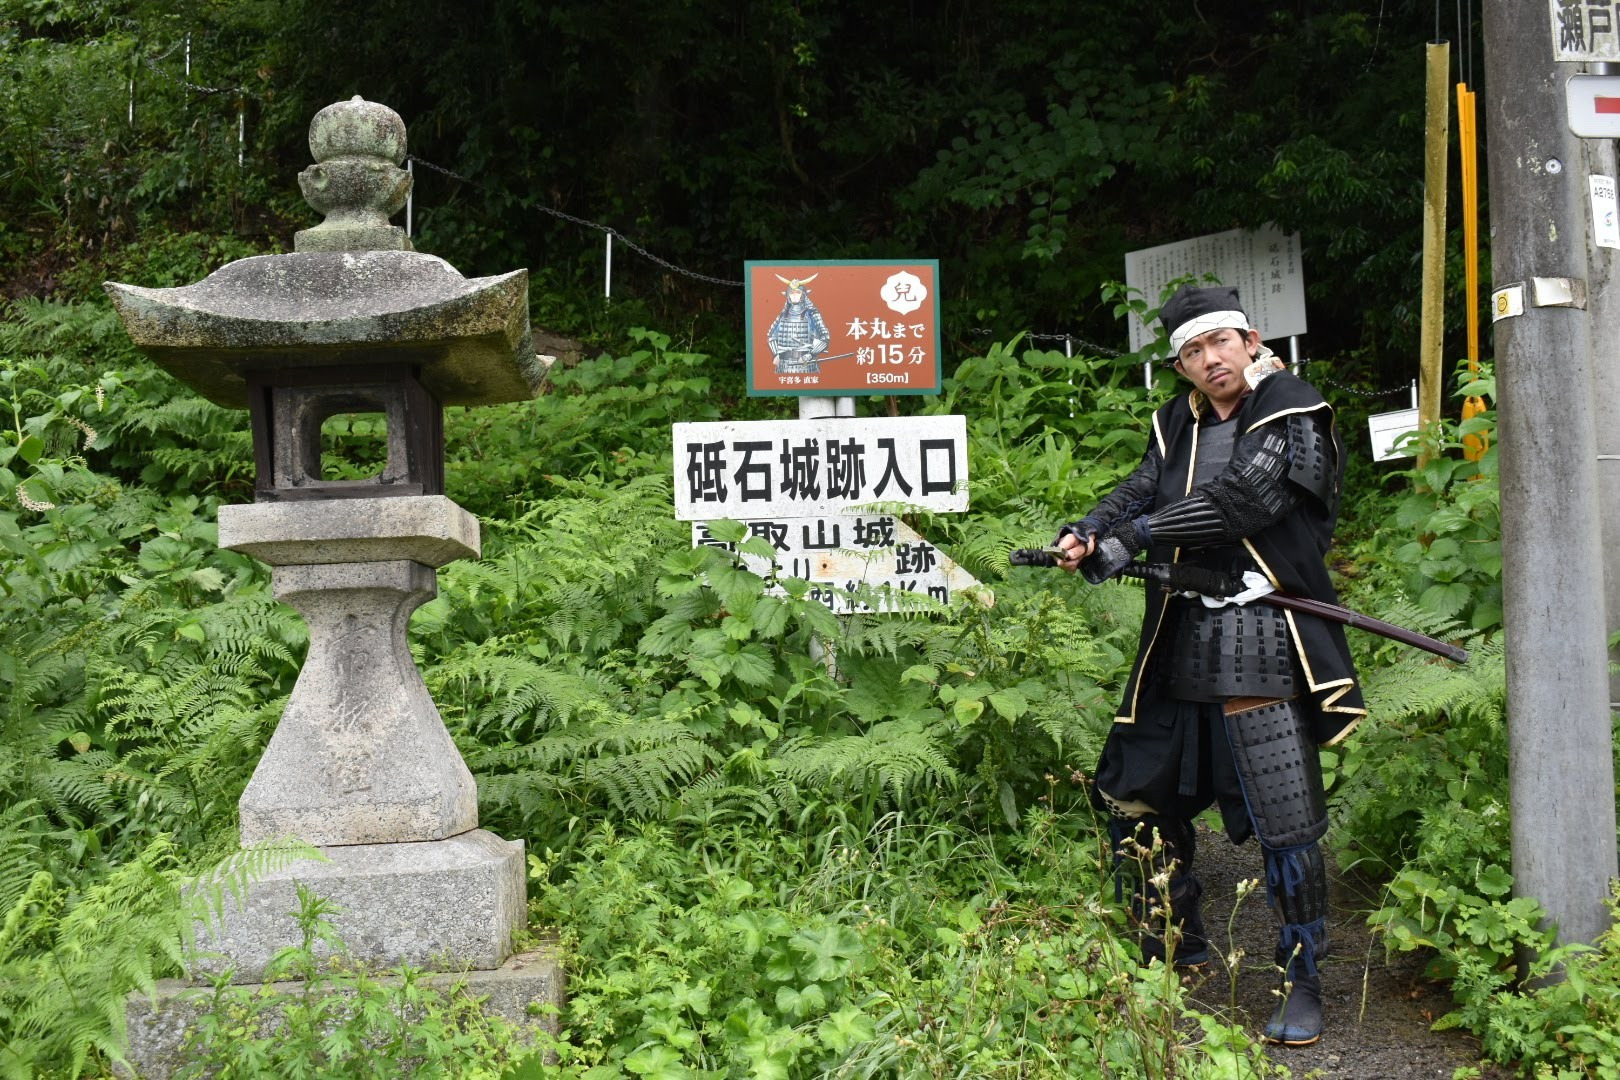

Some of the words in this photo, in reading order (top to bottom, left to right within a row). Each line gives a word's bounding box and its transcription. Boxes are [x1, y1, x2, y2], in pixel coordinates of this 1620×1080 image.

[1557, 0, 1620, 53] 瀬戸
[846, 317, 926, 340] 本丸まで
[856, 344, 926, 365] 約15分
[686, 437, 957, 504] 砥石城跡入口
